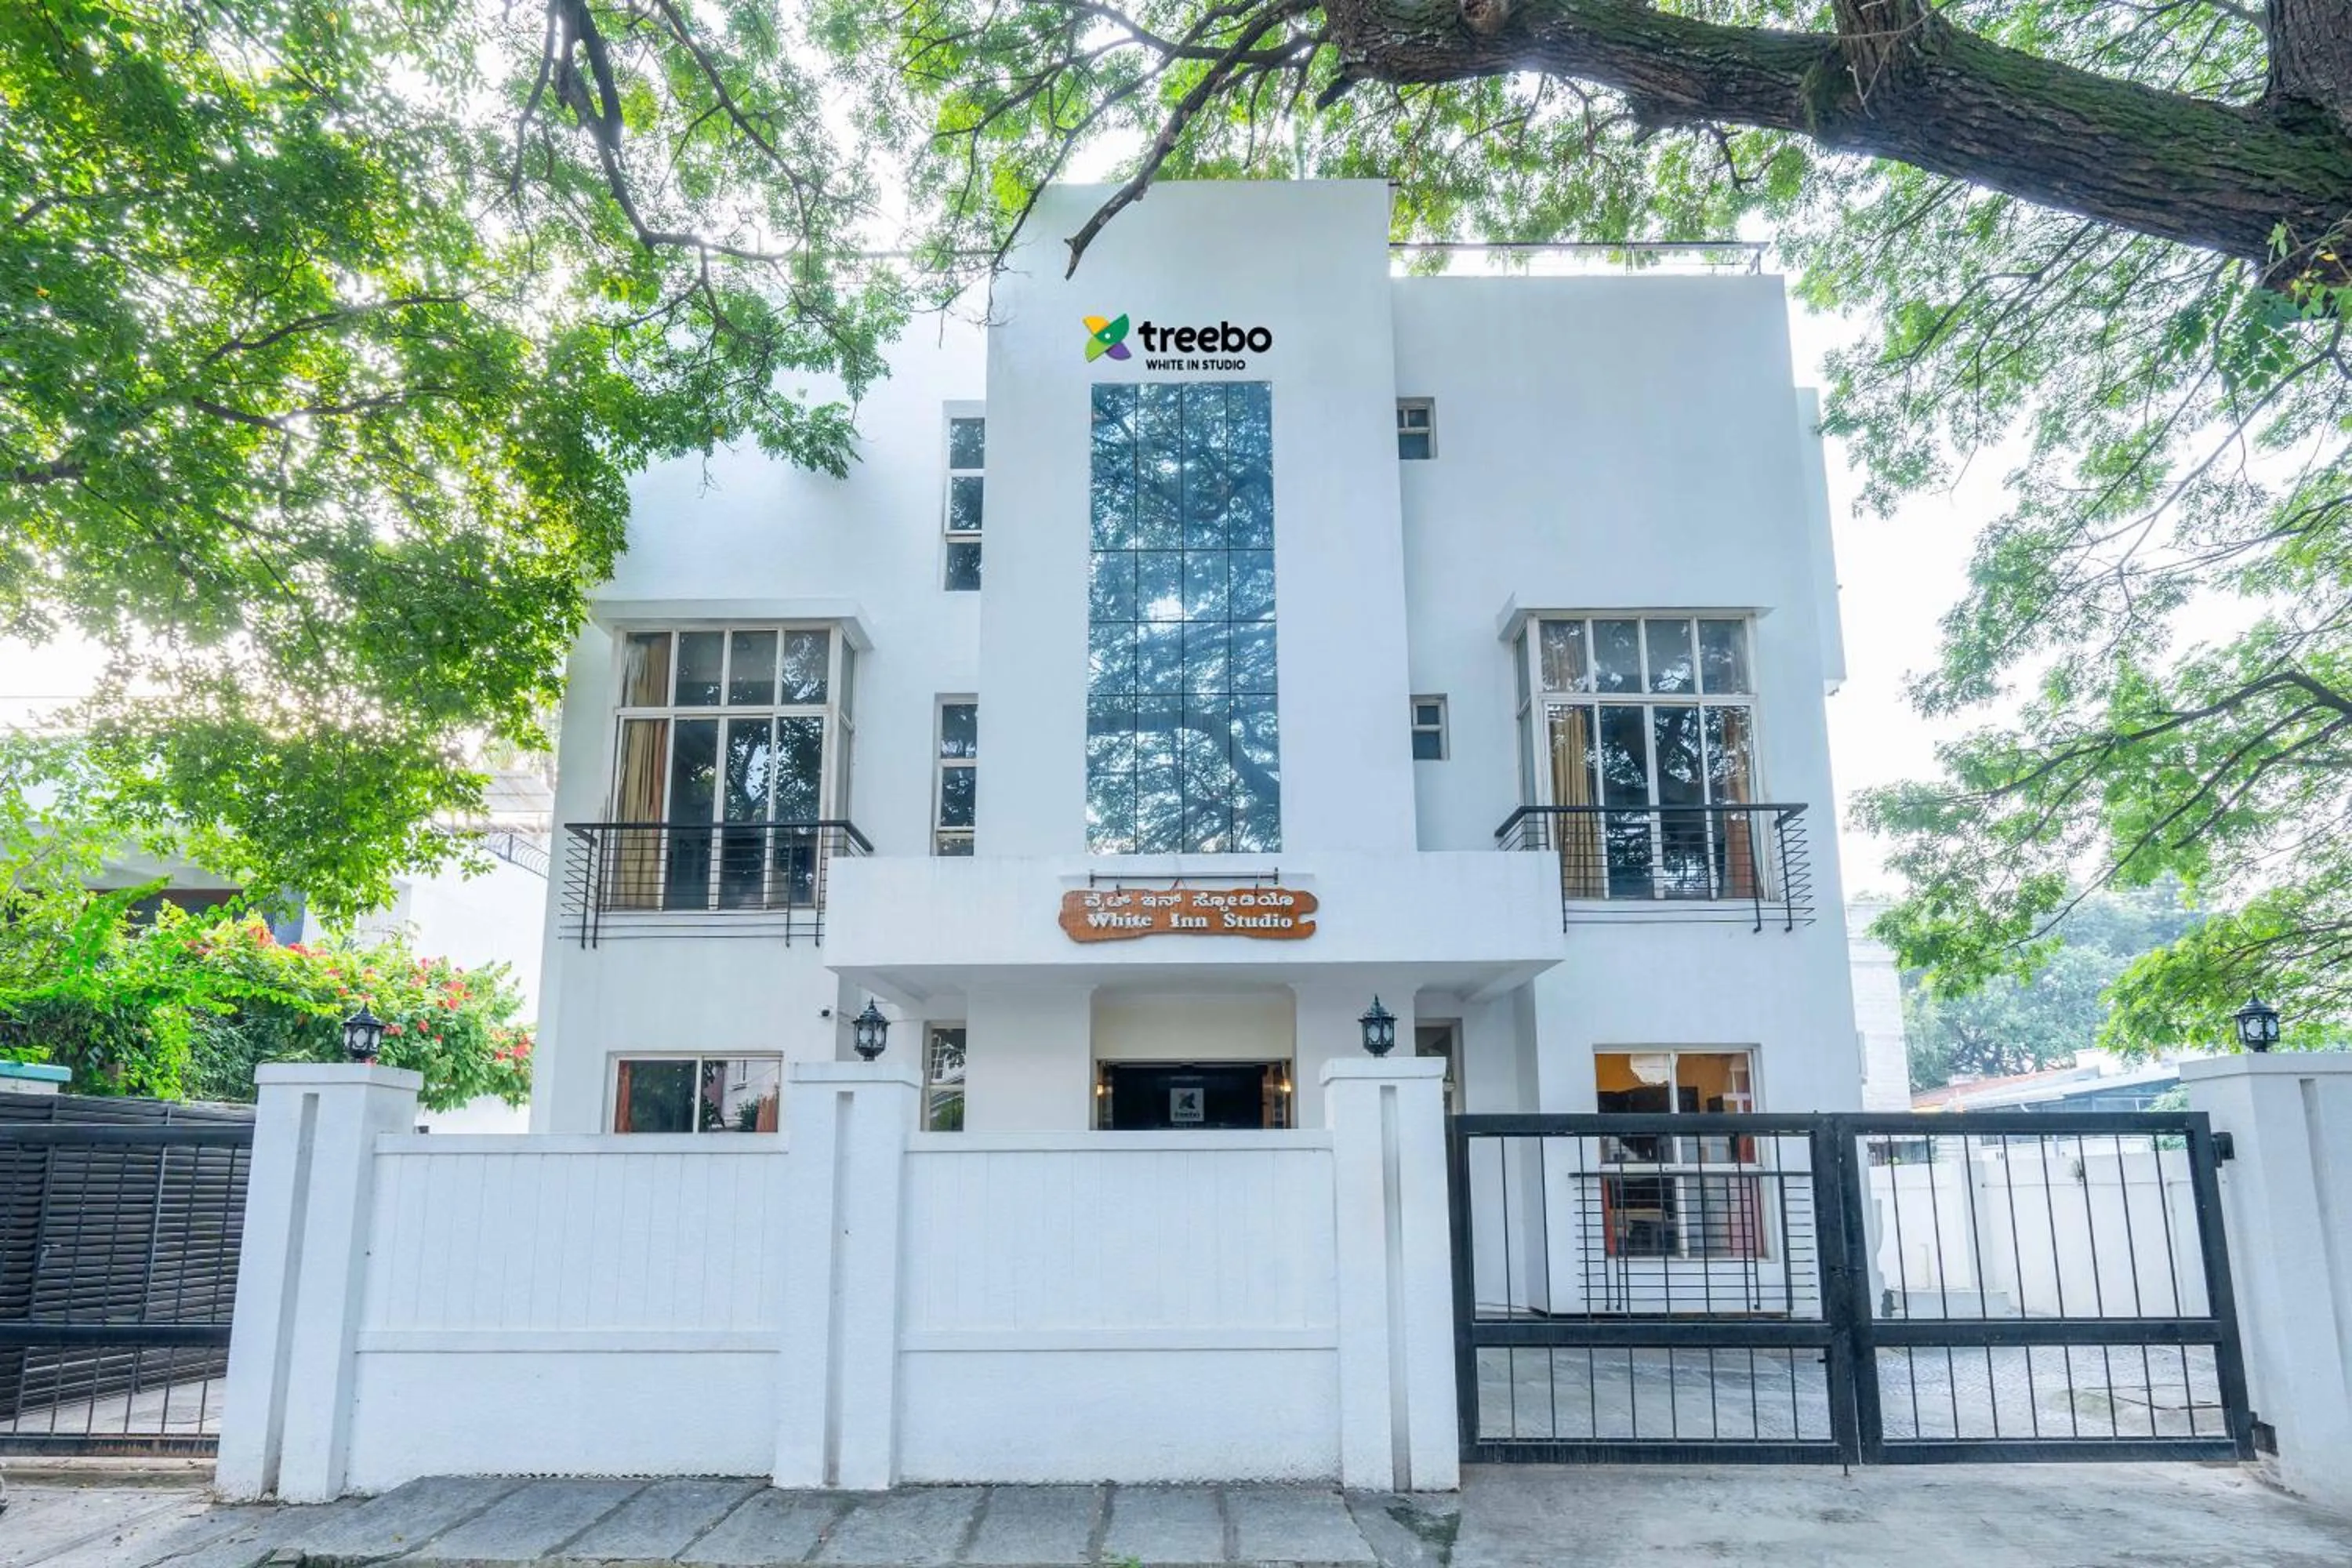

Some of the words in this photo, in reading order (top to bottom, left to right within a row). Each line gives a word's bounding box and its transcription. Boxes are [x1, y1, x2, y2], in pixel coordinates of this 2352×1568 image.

[1138, 321, 1272, 353] treebo
[1145, 359, 1184, 370] WHITE
[1186, 359, 1199, 370] IN
[1202, 359, 1246, 370] STUDIO
[1087, 912, 1152, 928] White
[1169, 912, 1209, 928] Inn
[1222, 913, 1293, 928] Studio
